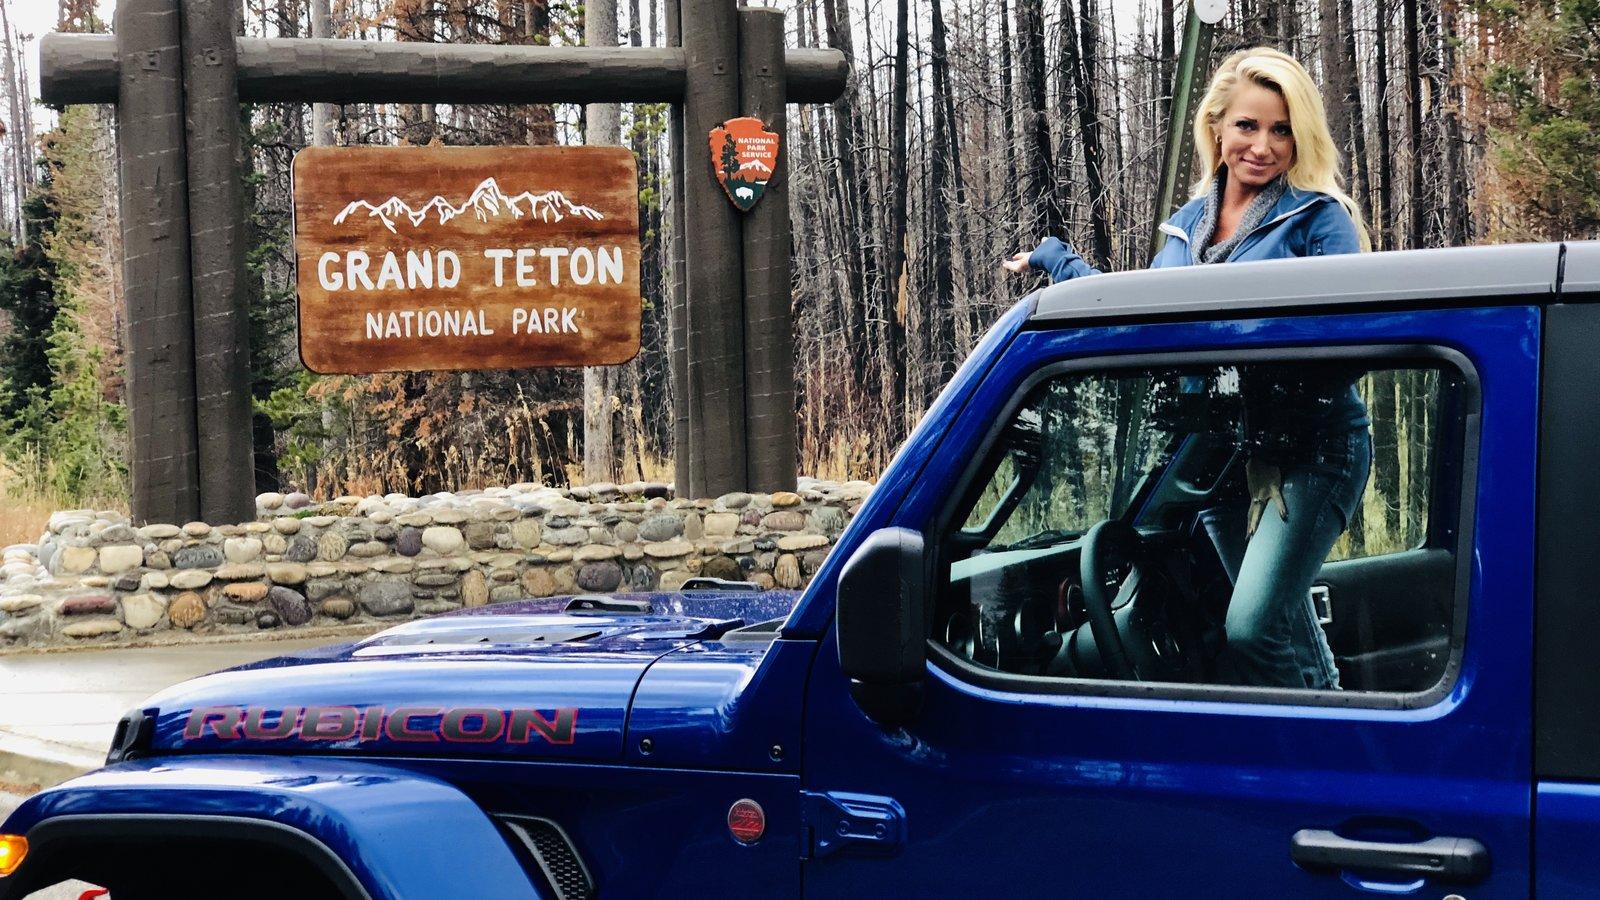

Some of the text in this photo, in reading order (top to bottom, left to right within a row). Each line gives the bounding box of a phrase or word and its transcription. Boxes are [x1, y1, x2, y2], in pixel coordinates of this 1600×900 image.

[317, 246, 624, 291] GRAND TETON
[366, 307, 579, 339] NATIONAL PARK
[183, 706, 579, 744] RUBICON
